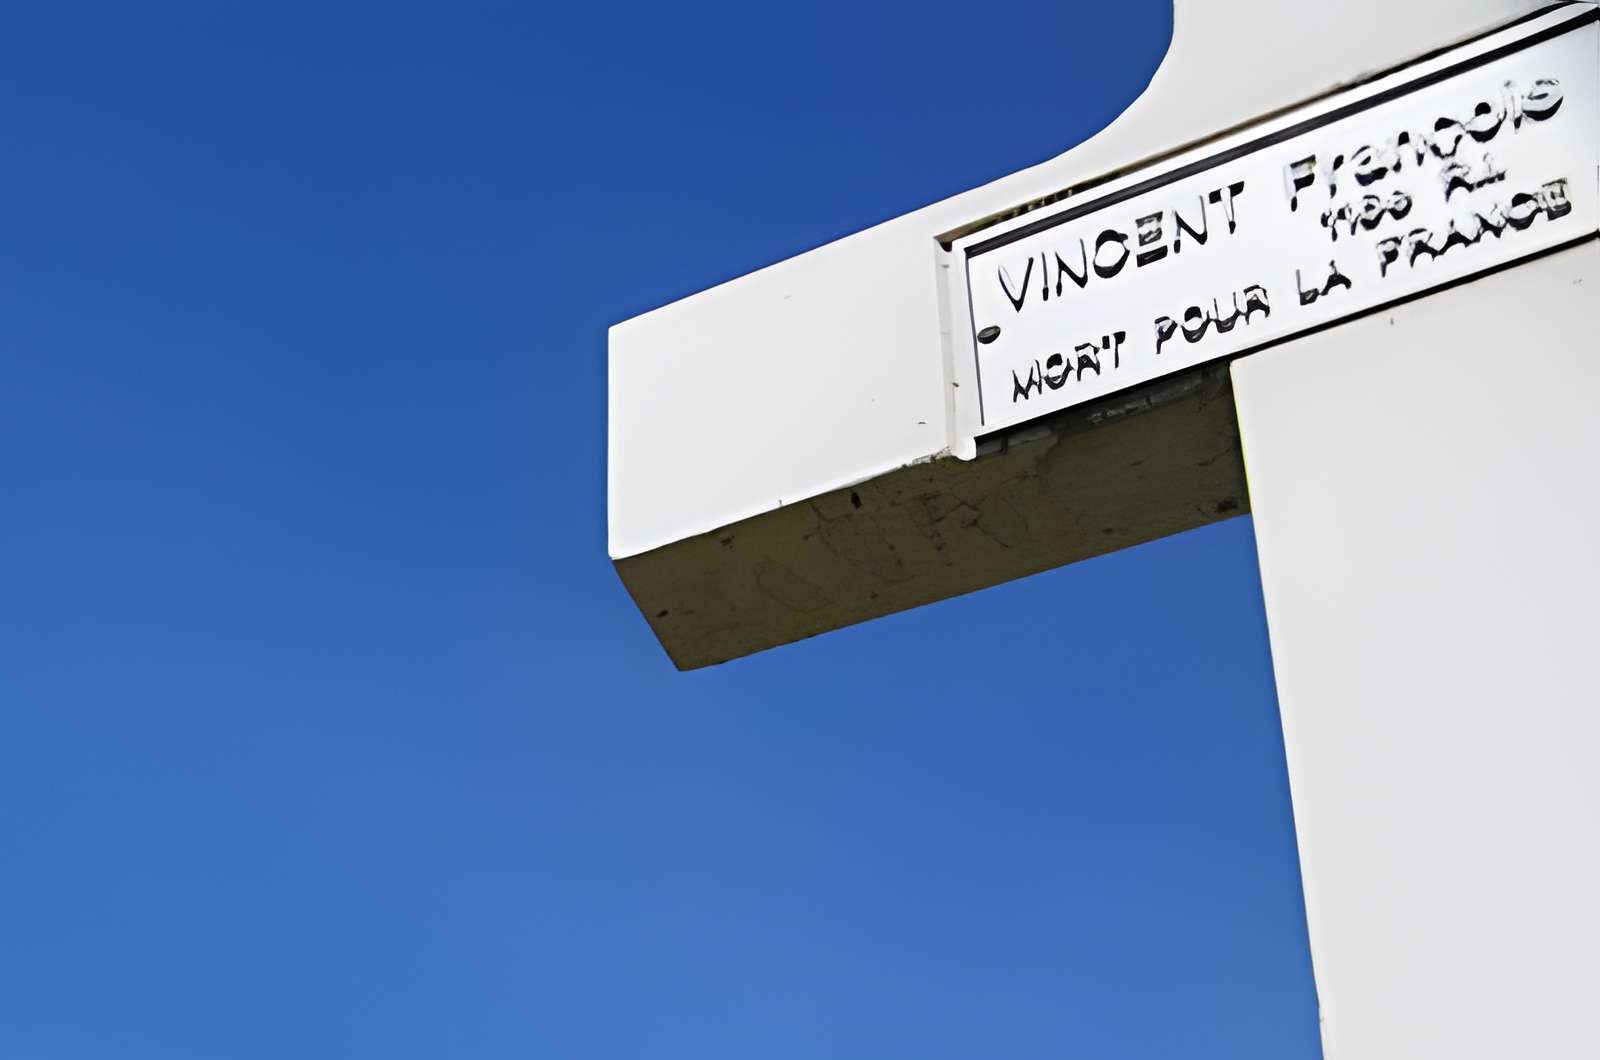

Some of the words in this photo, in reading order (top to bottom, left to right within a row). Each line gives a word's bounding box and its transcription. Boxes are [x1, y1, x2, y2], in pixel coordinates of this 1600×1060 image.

[998, 181, 1245, 313] VINCENT
[1012, 331, 1127, 403] MORT
[1154, 284, 1271, 354] POUR
[1296, 259, 1353, 306] LA
[1376, 178, 1572, 278] FRANCE
